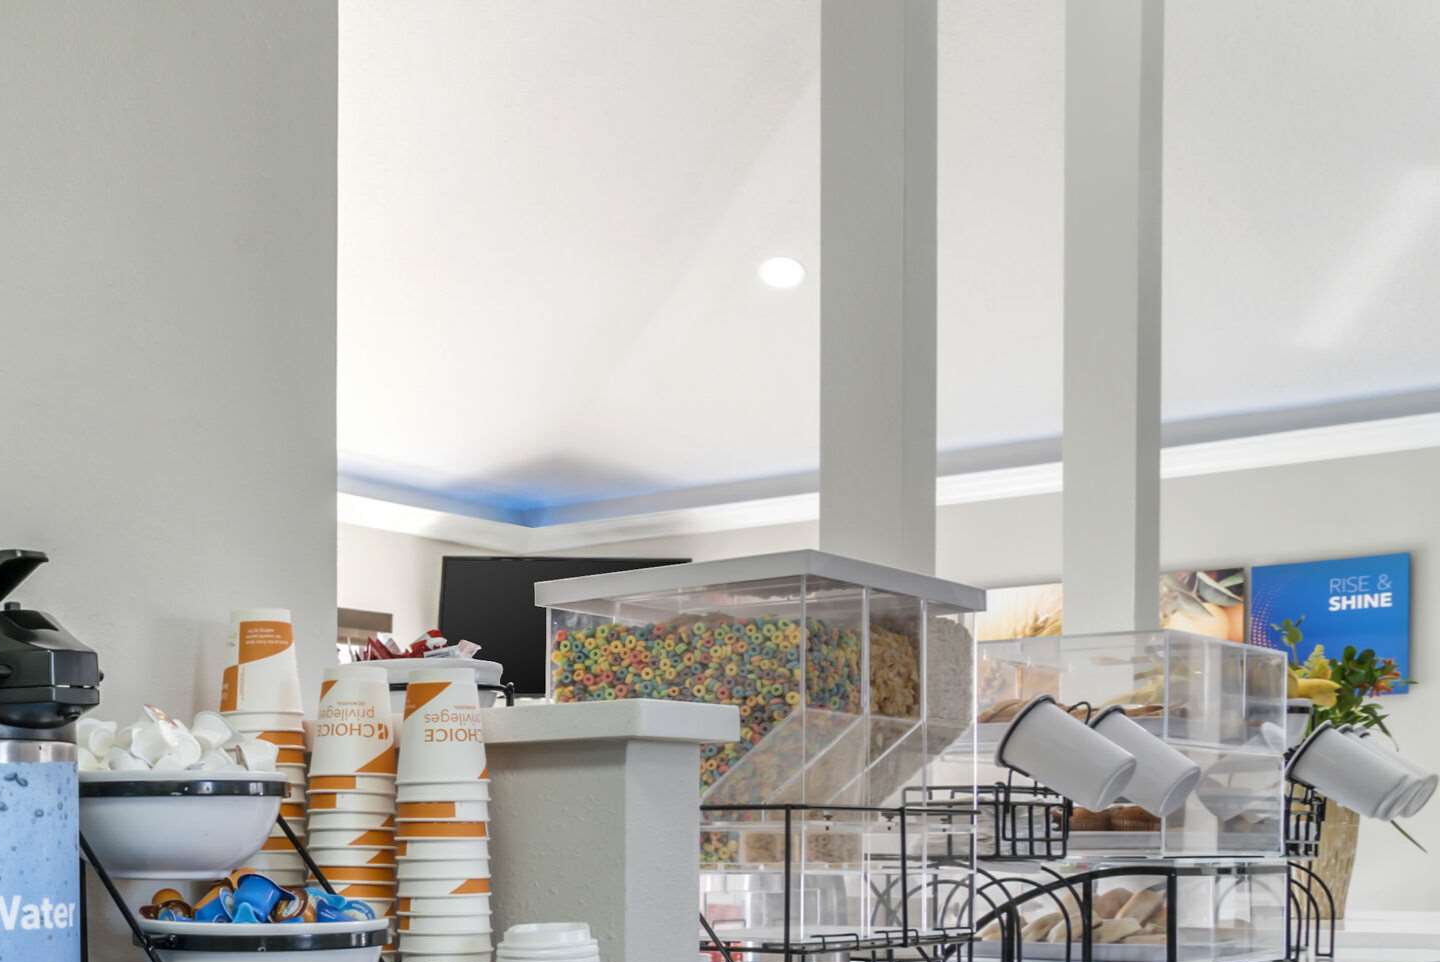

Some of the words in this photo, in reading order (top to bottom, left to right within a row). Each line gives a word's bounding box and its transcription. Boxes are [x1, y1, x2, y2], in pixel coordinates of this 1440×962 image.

[1329, 575, 1371, 593] RISE
[1376, 573, 1392, 591] &
[1328, 592, 1393, 612] SHINE
